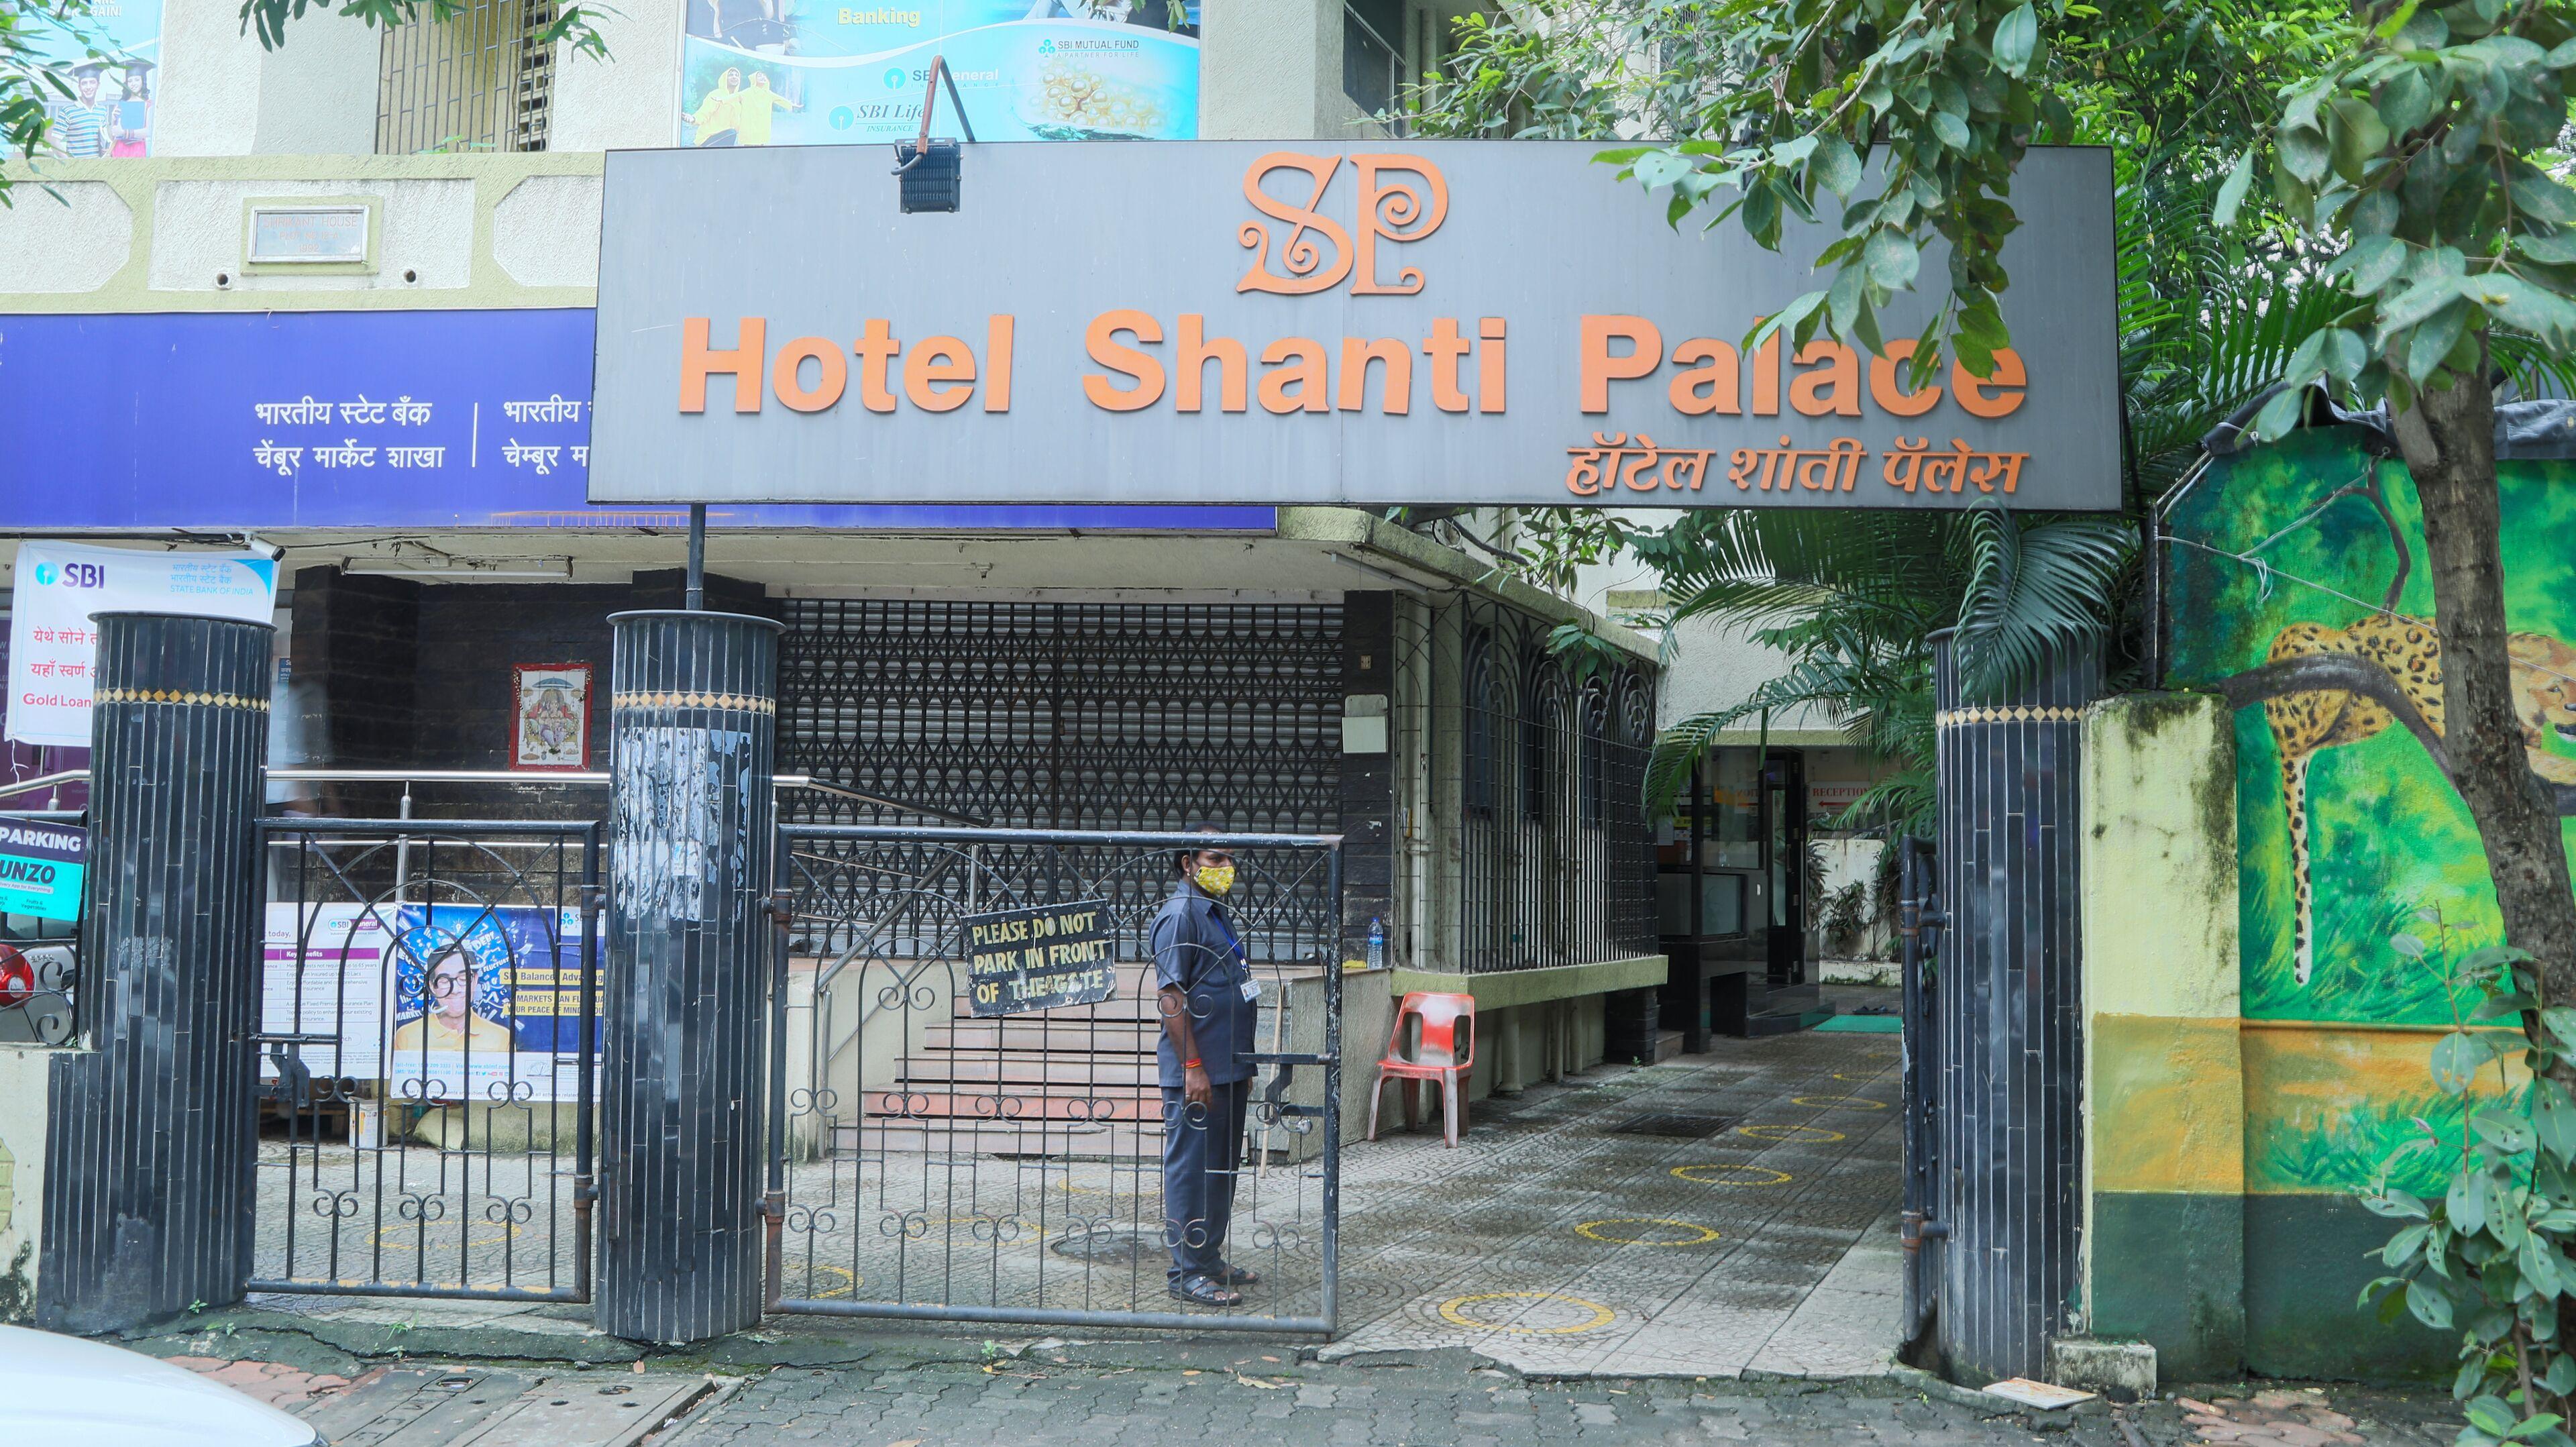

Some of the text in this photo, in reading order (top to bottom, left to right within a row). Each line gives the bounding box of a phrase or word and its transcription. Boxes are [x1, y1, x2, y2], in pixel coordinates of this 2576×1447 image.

[838, 7, 920, 28] Banking
[1058, 40, 1139, 49] SBI MUTUAL FUND
[941, 68, 998, 81] eneral
[857, 103, 924, 121] SBI Life
[866, 125, 913, 133] INSURANCE
[263, 215, 358, 228] SHRIKANT HOUSE
[1236, 151, 1449, 296] SP
[280, 231, 301, 240] PLOT
[680, 309, 2029, 419] Hotel Shanti Palace
[254, 393, 433, 426] भारतीय स्टेट बँक
[503, 393, 582, 423] भारतीय
[252, 438, 446, 476] चेंबूर मार्केट शाखा
[501, 437, 561, 475] चेम्बूर
[1565, 431, 2031, 497] हॉटेल शांती पॅलेस
[62, 563, 105, 590] SBI
[170, 574, 197, 584] भारतीय
[200, 574, 216, 584] स्टेट
[172, 563, 199, 572] भारतीय
[201, 564, 217, 574] स्टेट
[170, 585, 194, 593] STATE
[33, 625, 54, 643] येथे
[58, 627, 86, 645] सोने
[30, 657, 56, 678] यहाँ
[58, 661, 86, 678] स्वर्ण
[23, 693, 92, 708] Gold Loan
[0, 826, 81, 852] PARKING
[268, 930, 291, 939] today,
[972, 911, 1096, 946] PLEASE DO NOT
[472, 930, 495, 951] DEBT
[973, 940, 1106, 975] PARK IN FRONT
[521, 972, 555, 980] Balance
[977, 981, 999, 1004] OF
